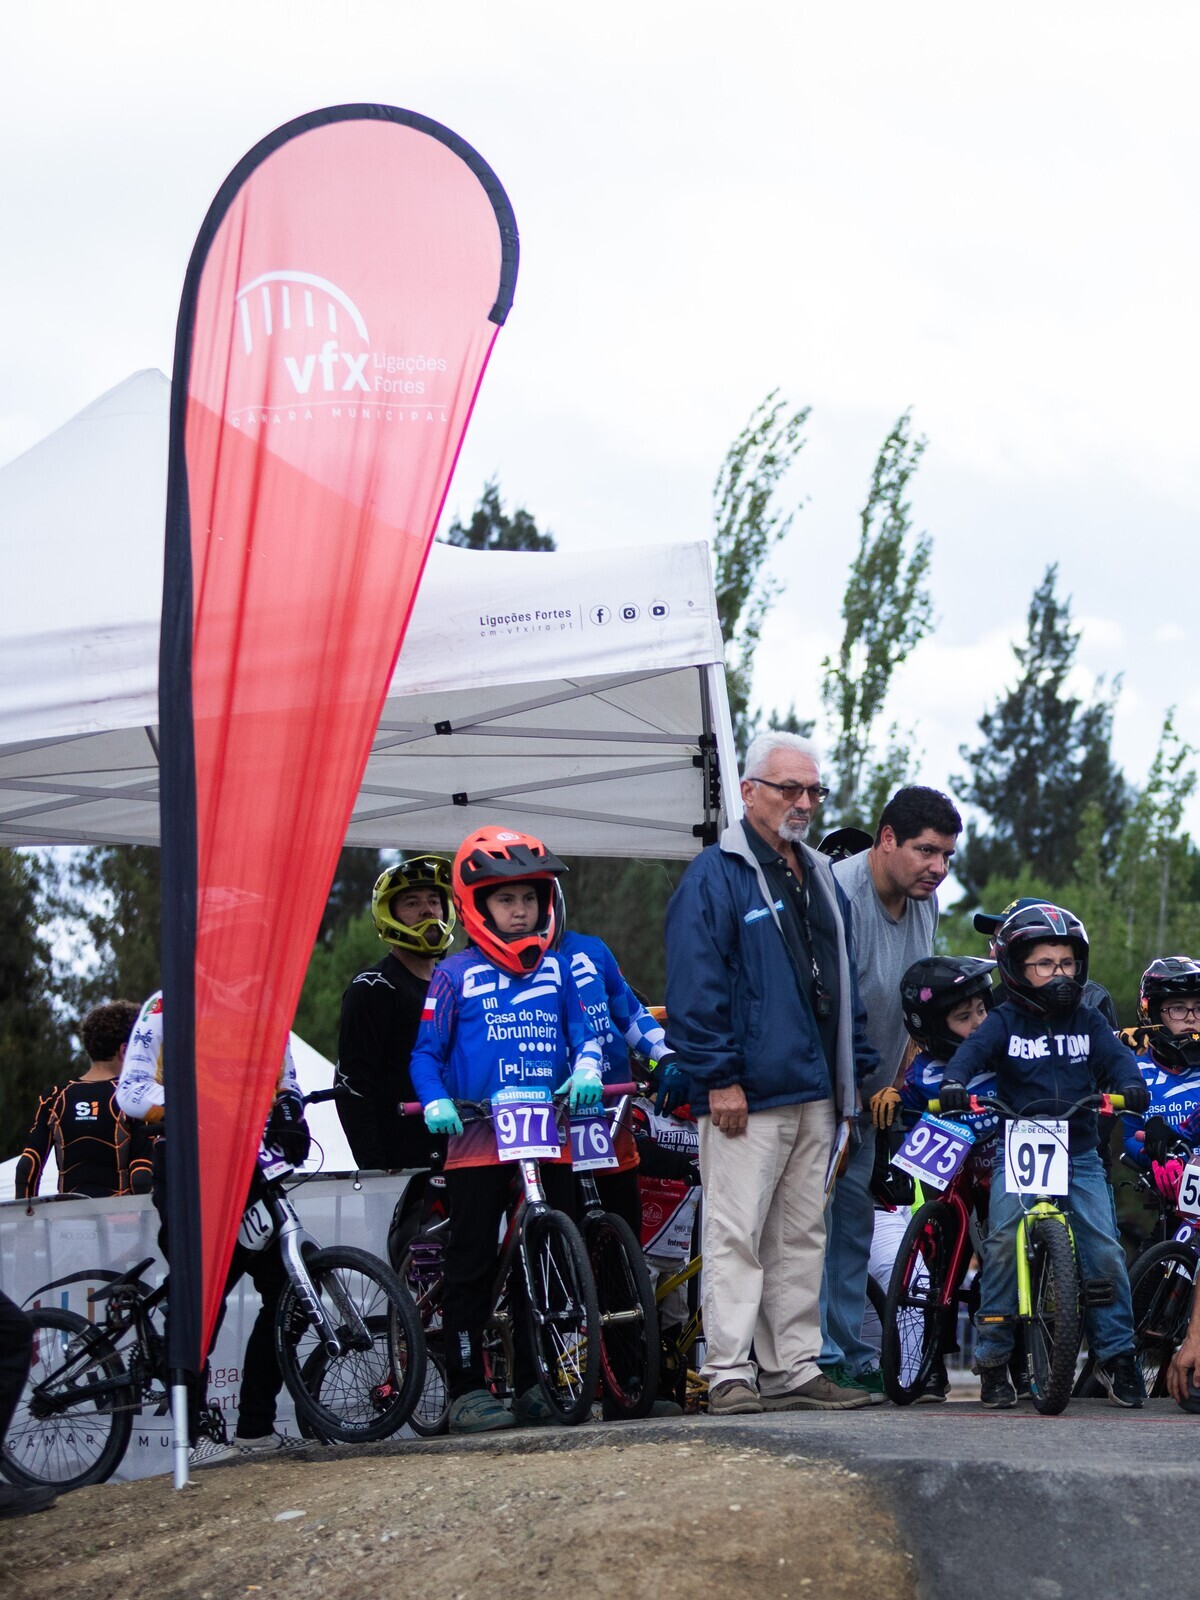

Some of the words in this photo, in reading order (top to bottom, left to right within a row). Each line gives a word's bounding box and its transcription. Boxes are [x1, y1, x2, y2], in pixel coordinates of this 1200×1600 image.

[284, 340, 371, 394] vfx
[373, 351, 447, 375] Ligações
[374, 375, 425, 395] Fortes
[331, 407, 448, 423] MUNICIPAL
[480, 611, 532, 628] Ligações
[535, 609, 572, 621] Fortes
[587, 1001, 608, 1016] ovo
[485, 1012, 516, 1025] Casa
[518, 1009, 533, 1022] do
[525, 1067, 553, 1078] LASER
[497, 1090, 546, 1101] SHIMANO
[1168, 1101, 1182, 1112] do
[496, 1106, 551, 1145] 977
[656, 1130, 699, 1146] TEAMBM
[904, 1126, 965, 1174] 975
[1017, 1142, 1056, 1188] 97
[340, 1420, 356, 1430] box
[355, 1422, 370, 1430] one
[8, 1432, 95, 1451] CÂMAR
